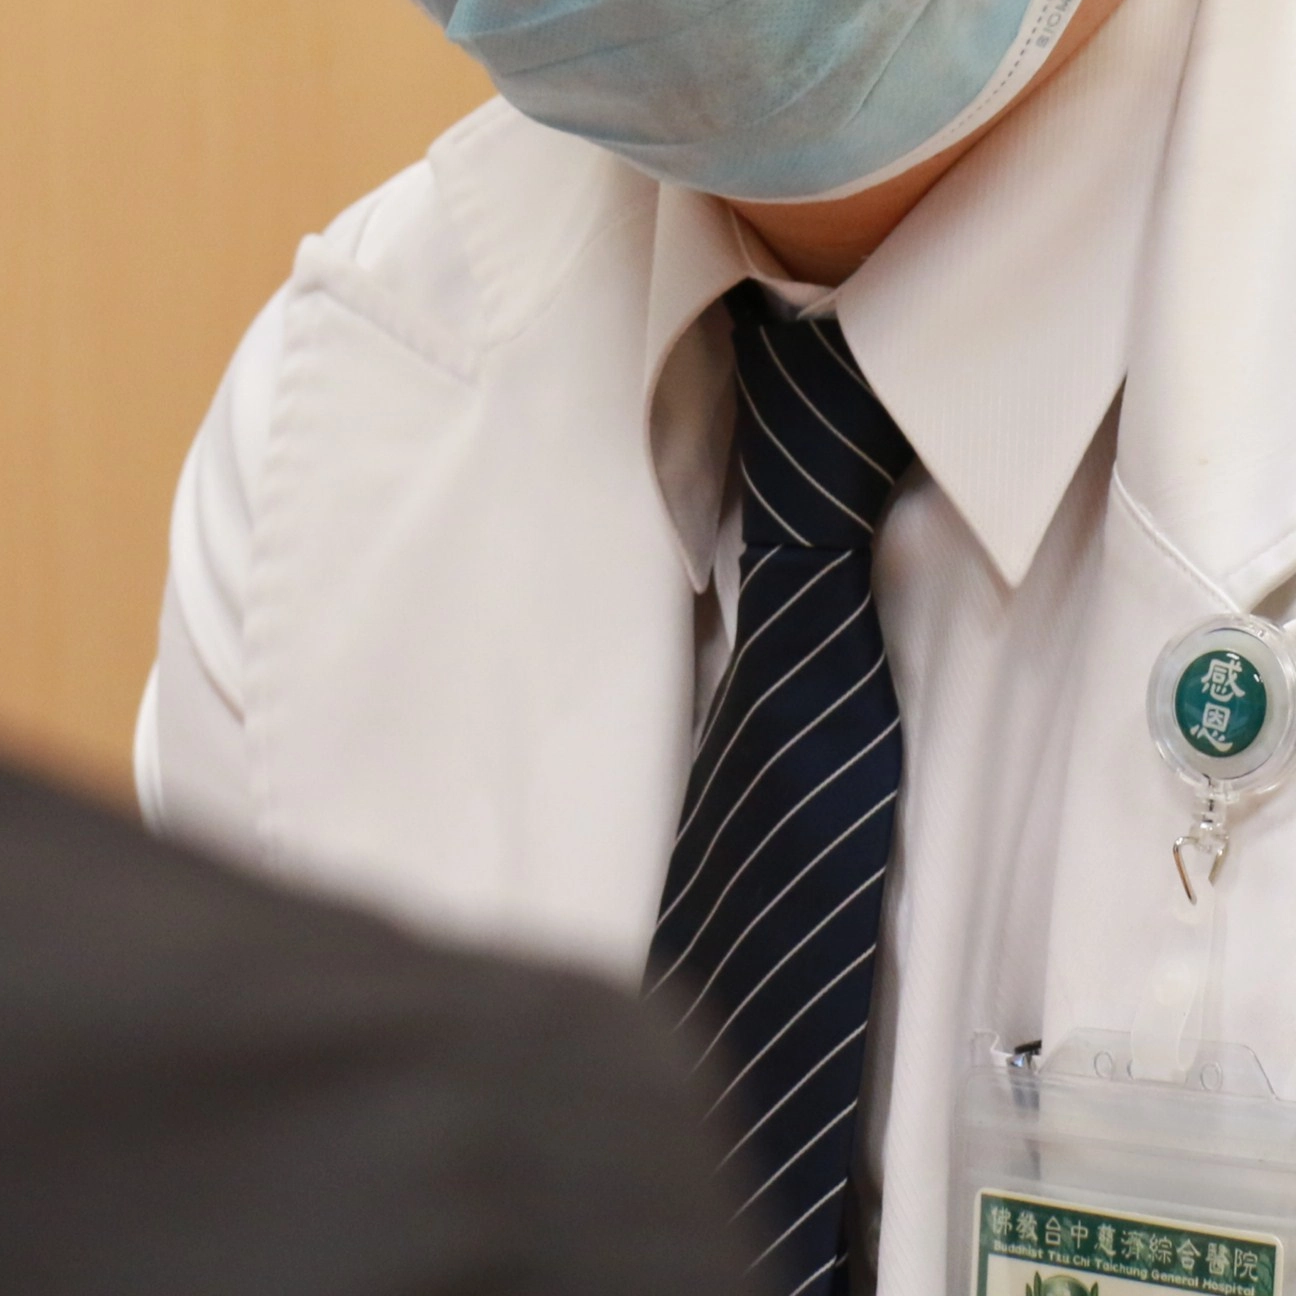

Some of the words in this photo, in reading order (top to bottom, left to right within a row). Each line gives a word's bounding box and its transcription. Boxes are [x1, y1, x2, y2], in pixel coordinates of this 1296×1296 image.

[1190, 658, 1246, 754] 感恩
[991, 1206, 1260, 1282] 佛教台中慈濟綜合醫院
[993, 1240, 1044, 1259] Buddhist
[1048, 1250, 1070, 1265] Tzu
[1072, 1254, 1090, 1268] Chi
[1095, 1259, 1149, 1281] Taichung
[1151, 1269, 1199, 1289] General
[1202, 1277, 1256, 1296] Hospital
